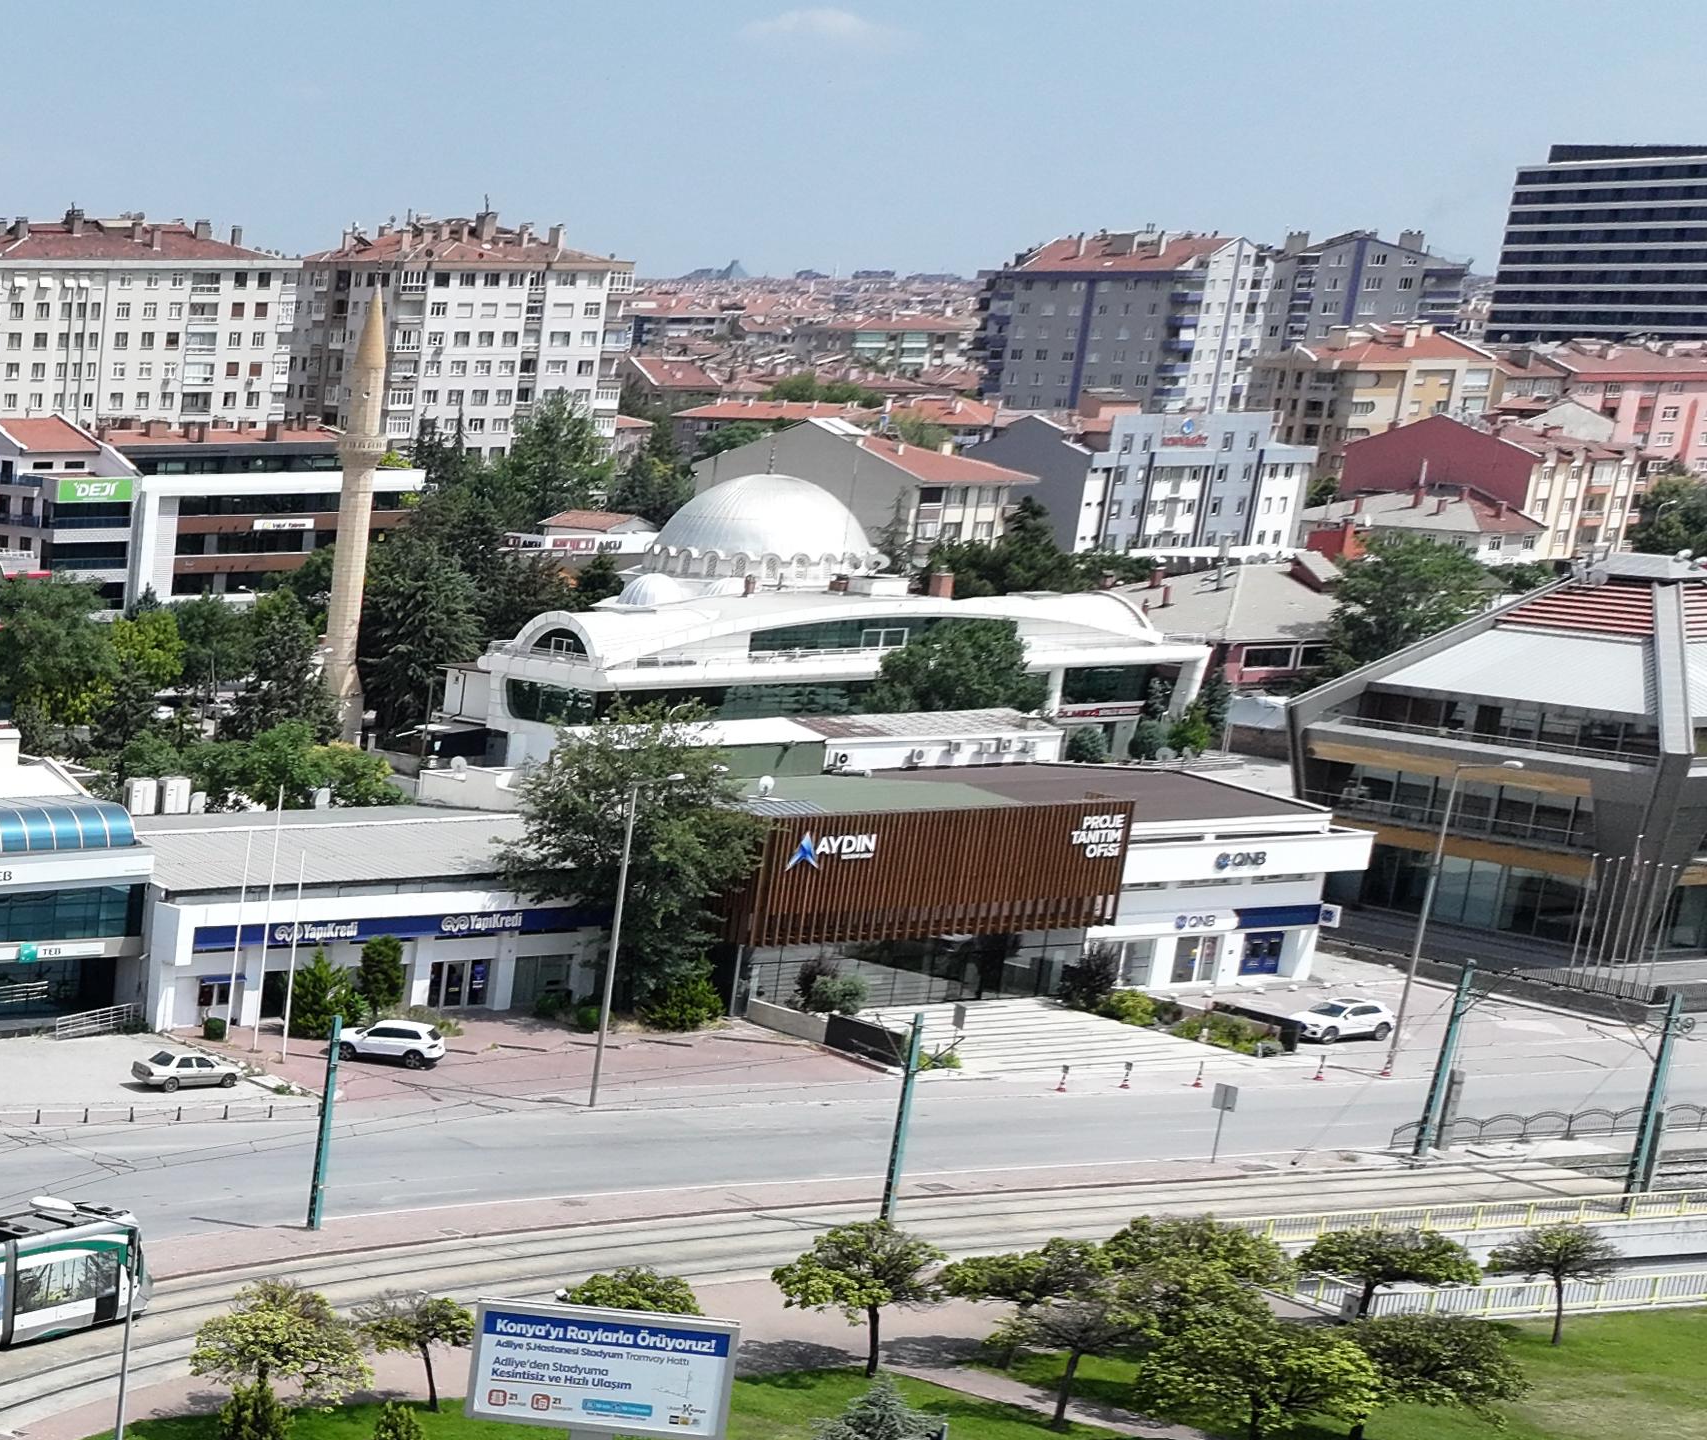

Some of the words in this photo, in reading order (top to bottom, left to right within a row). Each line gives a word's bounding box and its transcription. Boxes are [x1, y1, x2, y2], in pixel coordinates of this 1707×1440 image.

[1082, 813, 1125, 829] PROJE
[815, 834, 877, 855] AYDIN
[1071, 828, 1123, 845] TANITIM
[1232, 851, 1267, 866] QNB
[1188, 914, 1216, 928] QNB
[42, 948, 61, 956] TEB
[495, 1318, 564, 1341] Konya'yı
[566, 1327, 634, 1345] Raylarla
[636, 1329, 717, 1353] Örüyoruz!
[495, 1339, 524, 1350] Adliye
[580, 1347, 623, 1360] Stadyum
[625, 1352, 665, 1365] Tramvay
[492, 1356, 550, 1373] Adliye'den
[552, 1362, 609, 1378] Stadyuma
[491, 1367, 546, 1382] Kesintisiz
[548, 1374, 562, 1384] ve
[563, 1375, 589, 1386] Hızlı
[591, 1377, 632, 1391] Ulaşım
